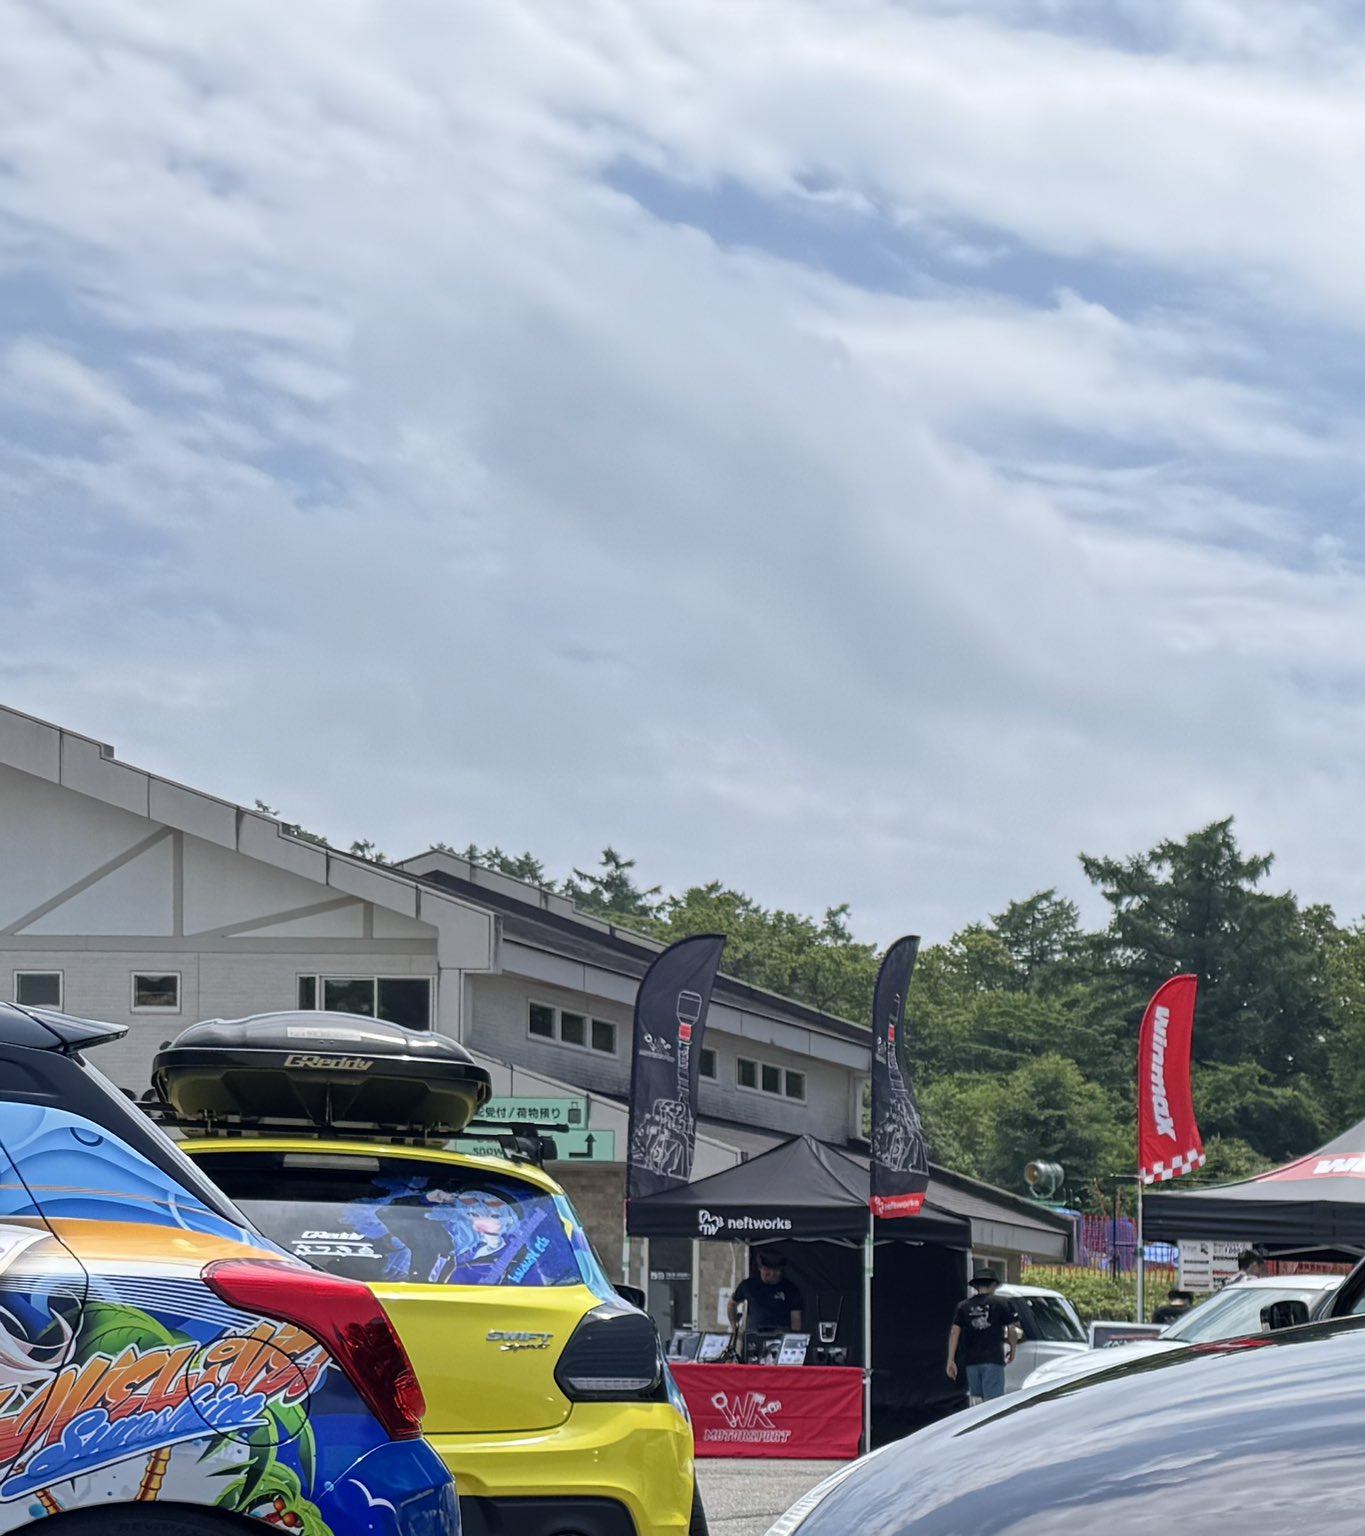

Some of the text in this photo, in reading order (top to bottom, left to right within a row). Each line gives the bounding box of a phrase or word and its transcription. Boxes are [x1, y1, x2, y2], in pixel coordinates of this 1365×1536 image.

[283, 1054, 375, 1071] GReddy
[1151, 1006, 1177, 1142] winmax
[727, 1217, 792, 1230] neftworks
[486, 1331, 554, 1342] SWIFT
[704, 1428, 792, 1442] MOTORSPORT
